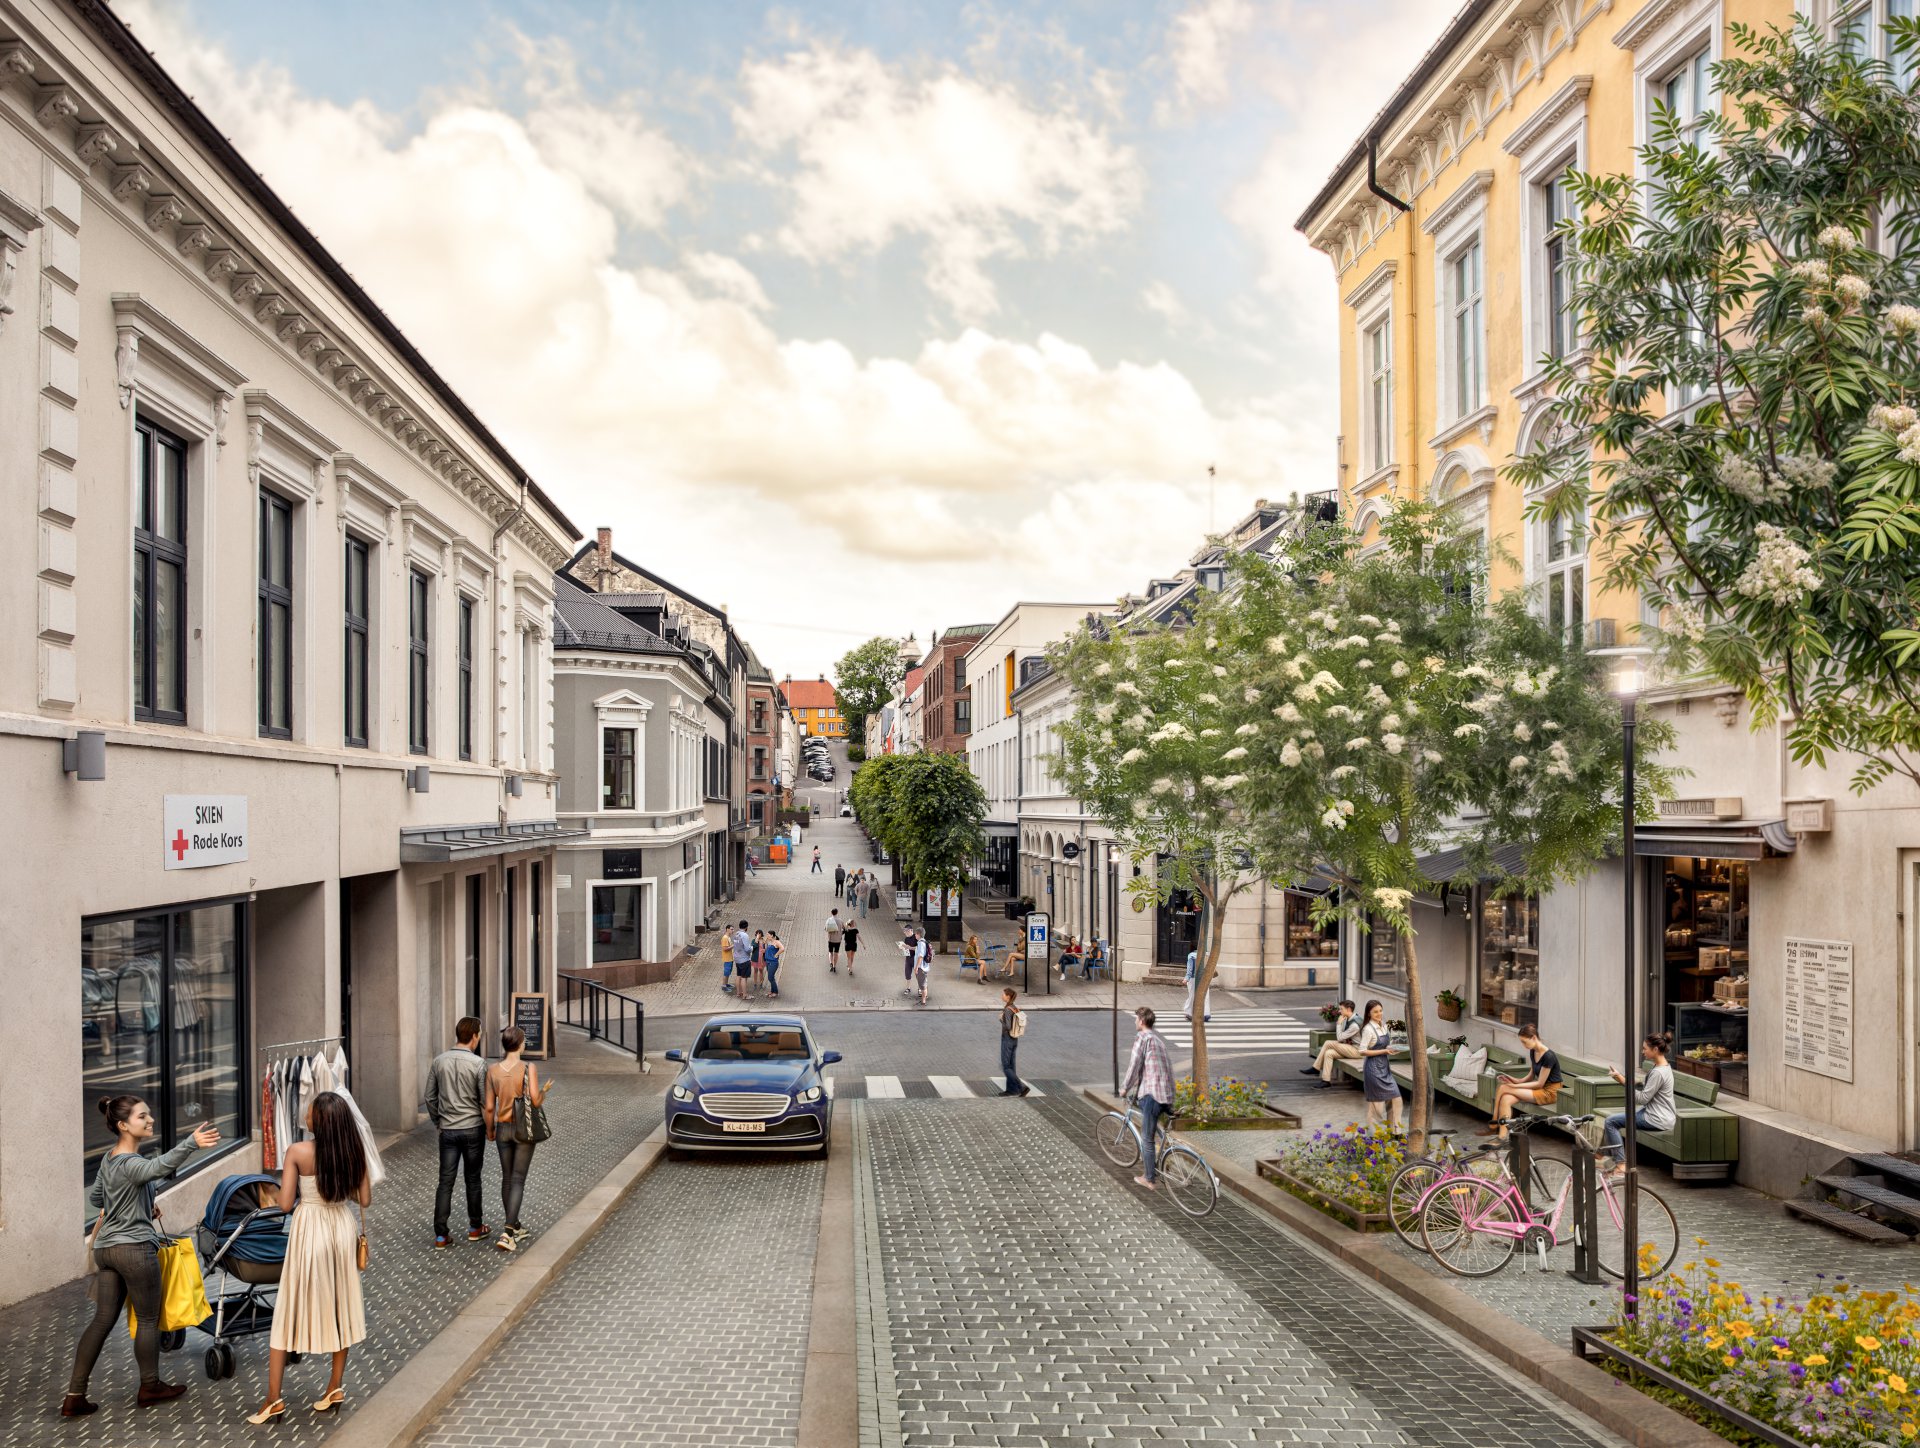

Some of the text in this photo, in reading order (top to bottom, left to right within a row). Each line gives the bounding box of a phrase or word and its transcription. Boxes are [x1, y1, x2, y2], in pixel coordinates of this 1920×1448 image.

[195, 805, 223, 825] SKIEN
[193, 832, 243, 849] Røde Kors
